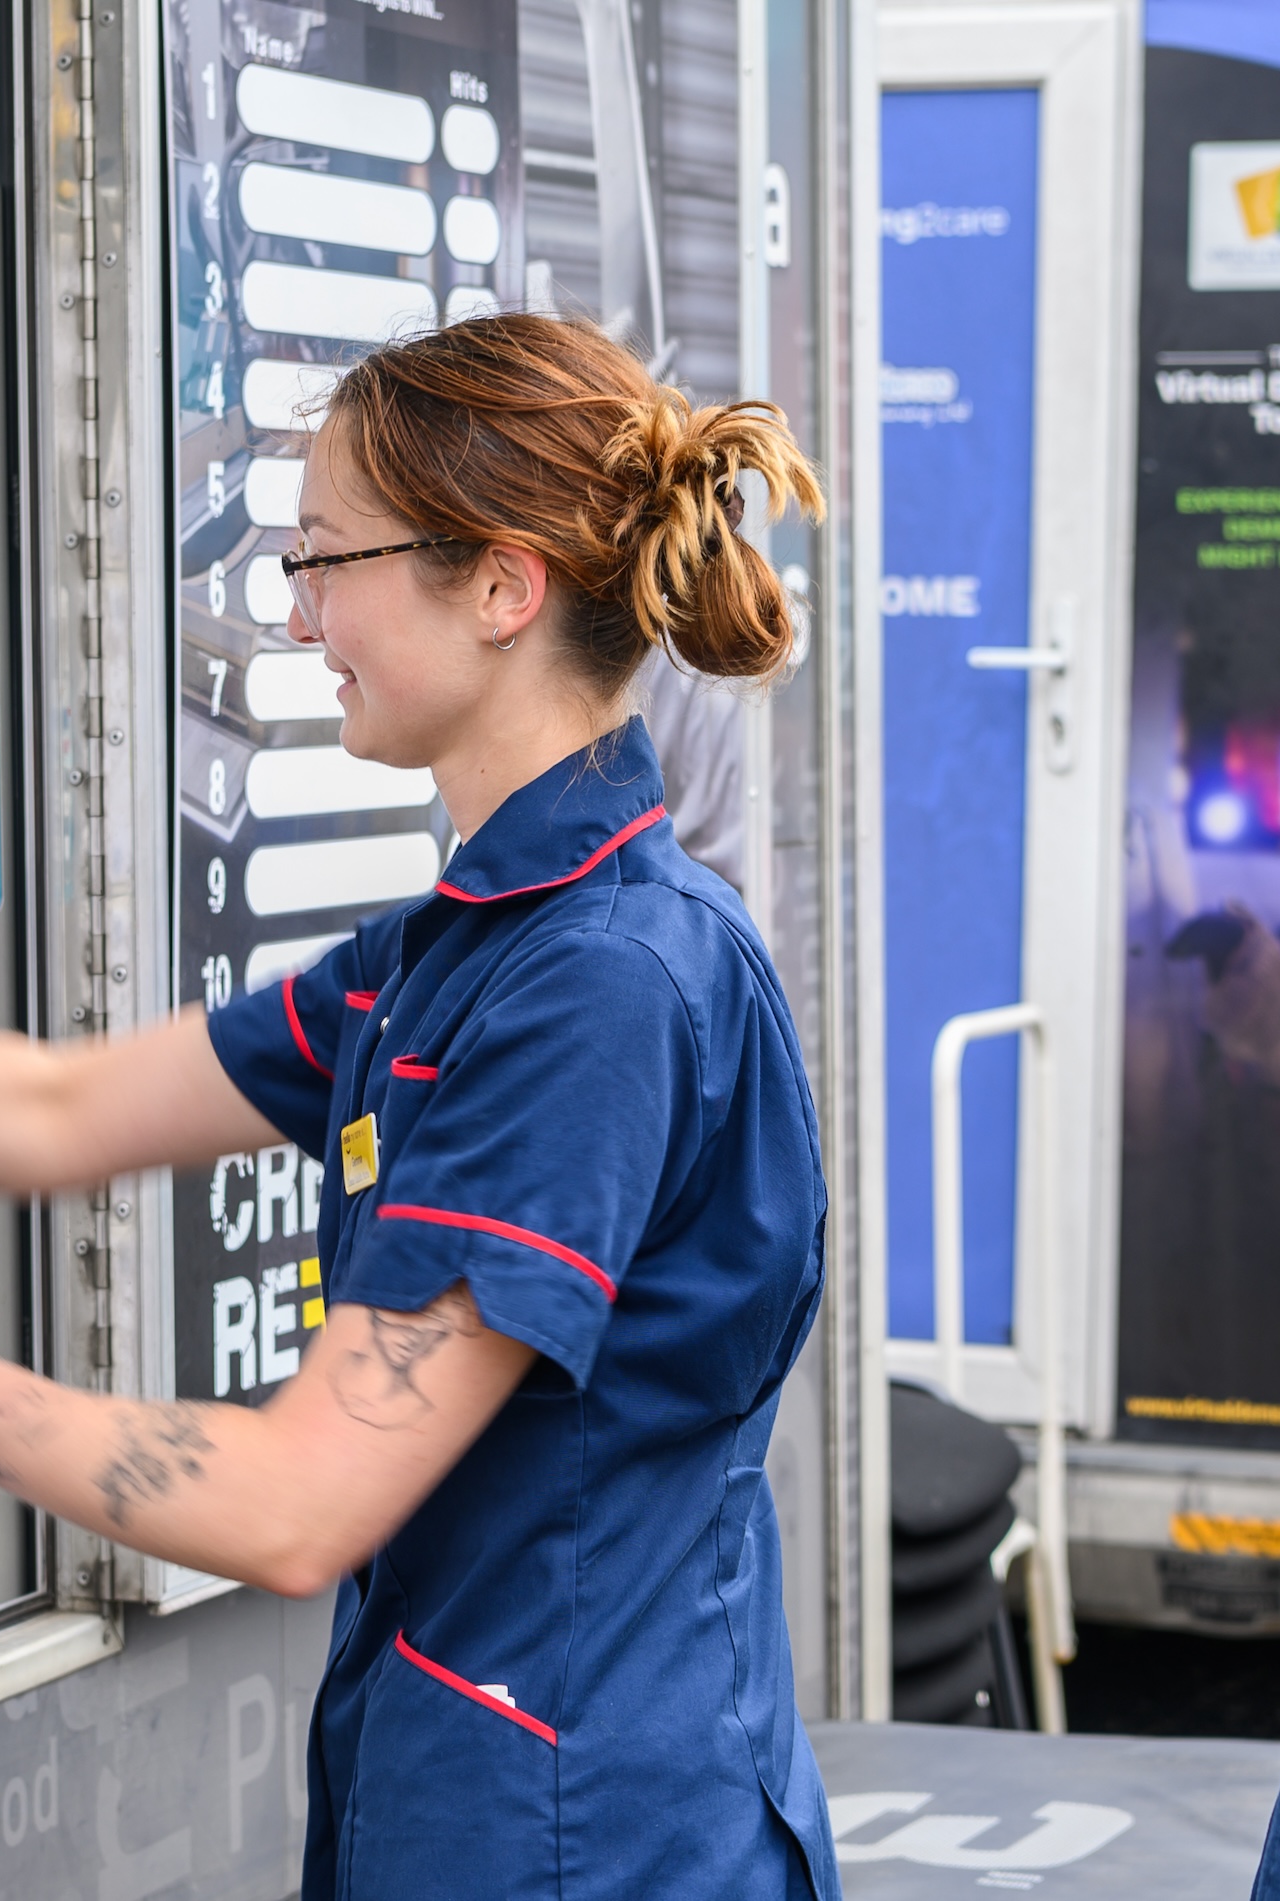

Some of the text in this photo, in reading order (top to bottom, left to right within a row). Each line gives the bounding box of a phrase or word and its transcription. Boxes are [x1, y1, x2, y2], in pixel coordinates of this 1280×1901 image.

[243, 25, 295, 62] Name
[201, 62, 216, 120] 1
[450, 70, 488, 103] Hits
[202, 162, 221, 220] 2
[204, 260, 223, 319] 3
[206, 360, 225, 419] 4
[1155, 369, 1266, 403] Virtual
[207, 461, 226, 518] 5
[1197, 541, 1275, 569] MIGHT
[208, 559, 227, 618] 6
[208, 659, 227, 717] 7
[207, 758, 227, 815] 8
[207, 856, 227, 915] 9
[201, 953, 232, 1013] 10
